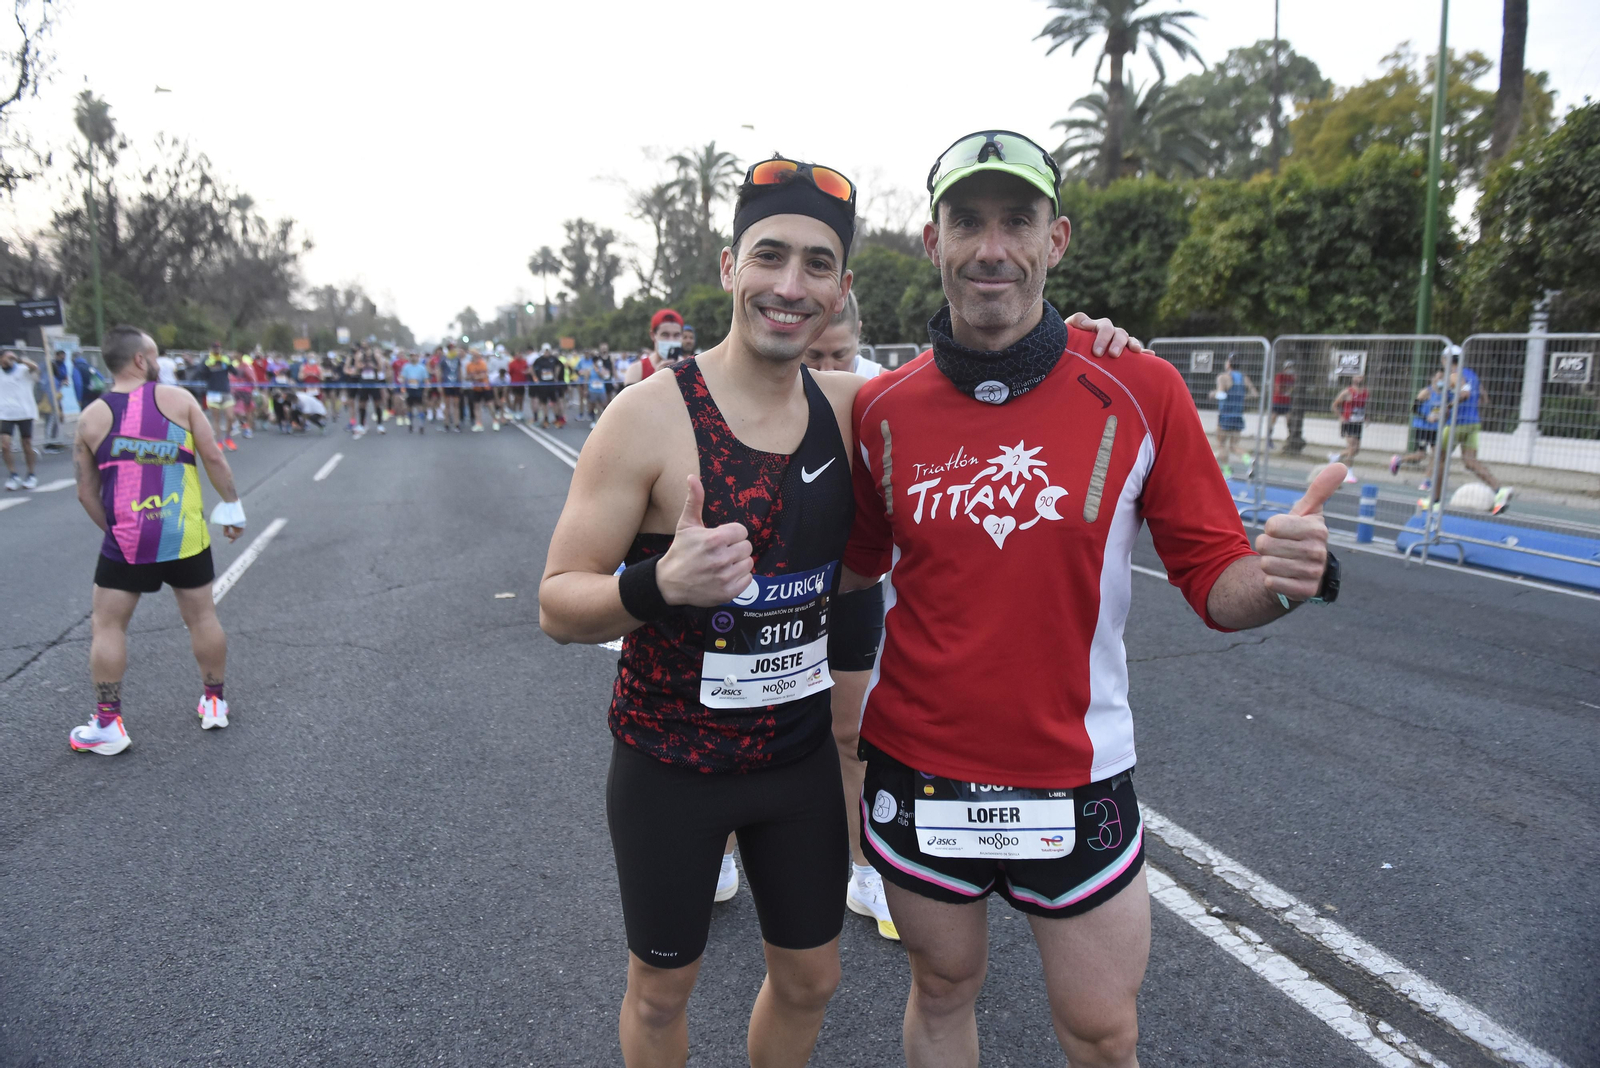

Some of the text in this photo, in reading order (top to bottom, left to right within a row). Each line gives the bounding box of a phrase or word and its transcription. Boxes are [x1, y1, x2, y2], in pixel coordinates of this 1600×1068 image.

[912, 445, 979, 481] Triatlón
[1012, 454, 1021, 466] 2
[907, 477, 1026, 524] TITAN
[1038, 495, 1054, 508] 90
[992, 522, 1006, 535] 21
[764, 572, 825, 601] ZURICH
[764, 608, 787, 617] MARATÓN
[760, 620, 804, 646] 3110
[750, 651, 804, 674] JOSETE
[967, 807, 1021, 823] LOFER
[651, 949, 678, 957] EVADICT
